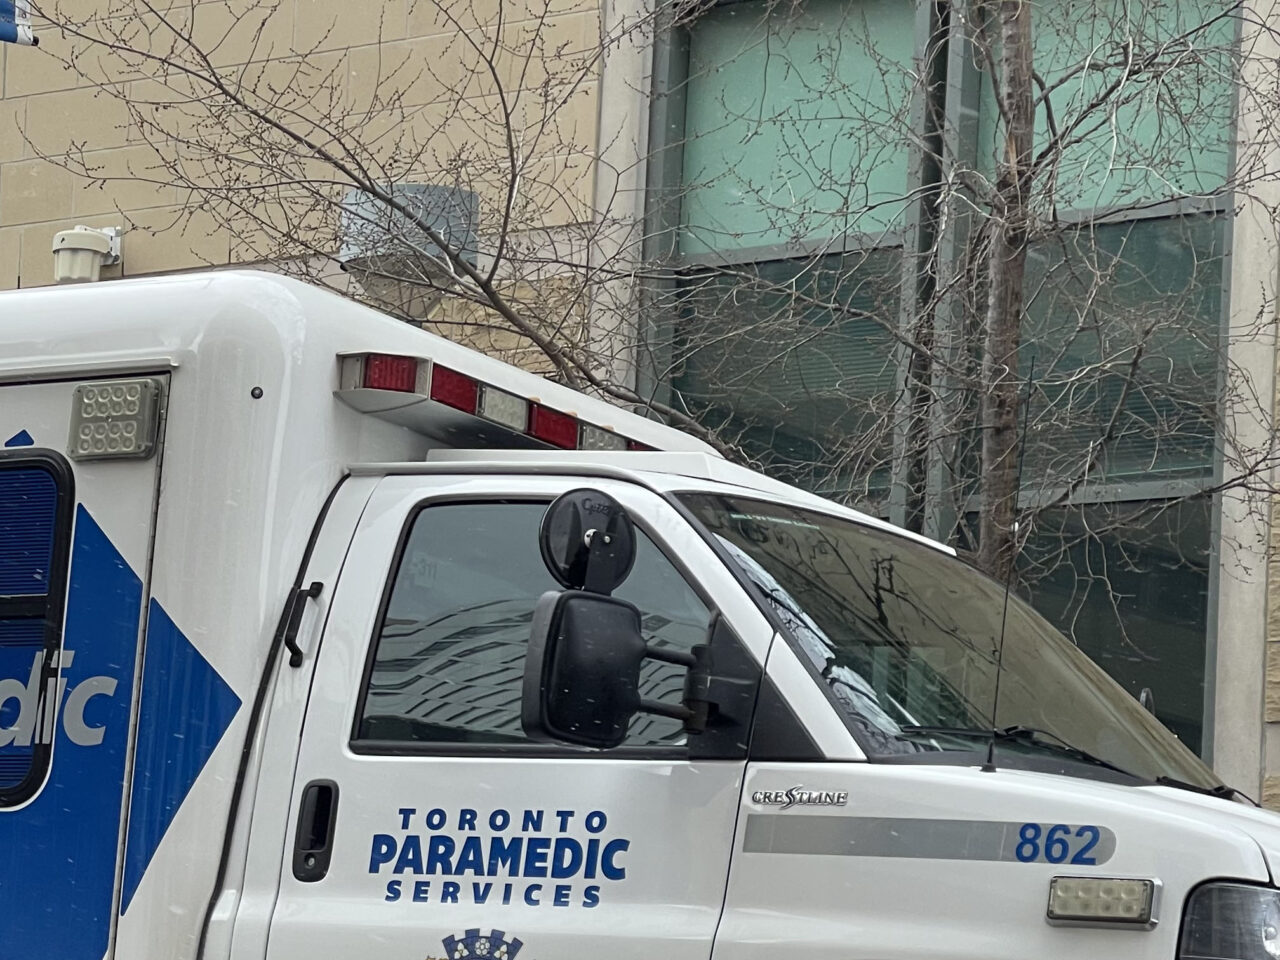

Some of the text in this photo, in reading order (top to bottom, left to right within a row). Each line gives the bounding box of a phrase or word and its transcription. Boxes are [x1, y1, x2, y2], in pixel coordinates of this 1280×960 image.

[751, 782, 849, 810] CRESTLINE
[398, 808, 609, 833] TORONTO
[368, 833, 631, 881] PARAMEDIC
[1014, 822, 1101, 866] 862
[384, 880, 602, 909] SERVICES
